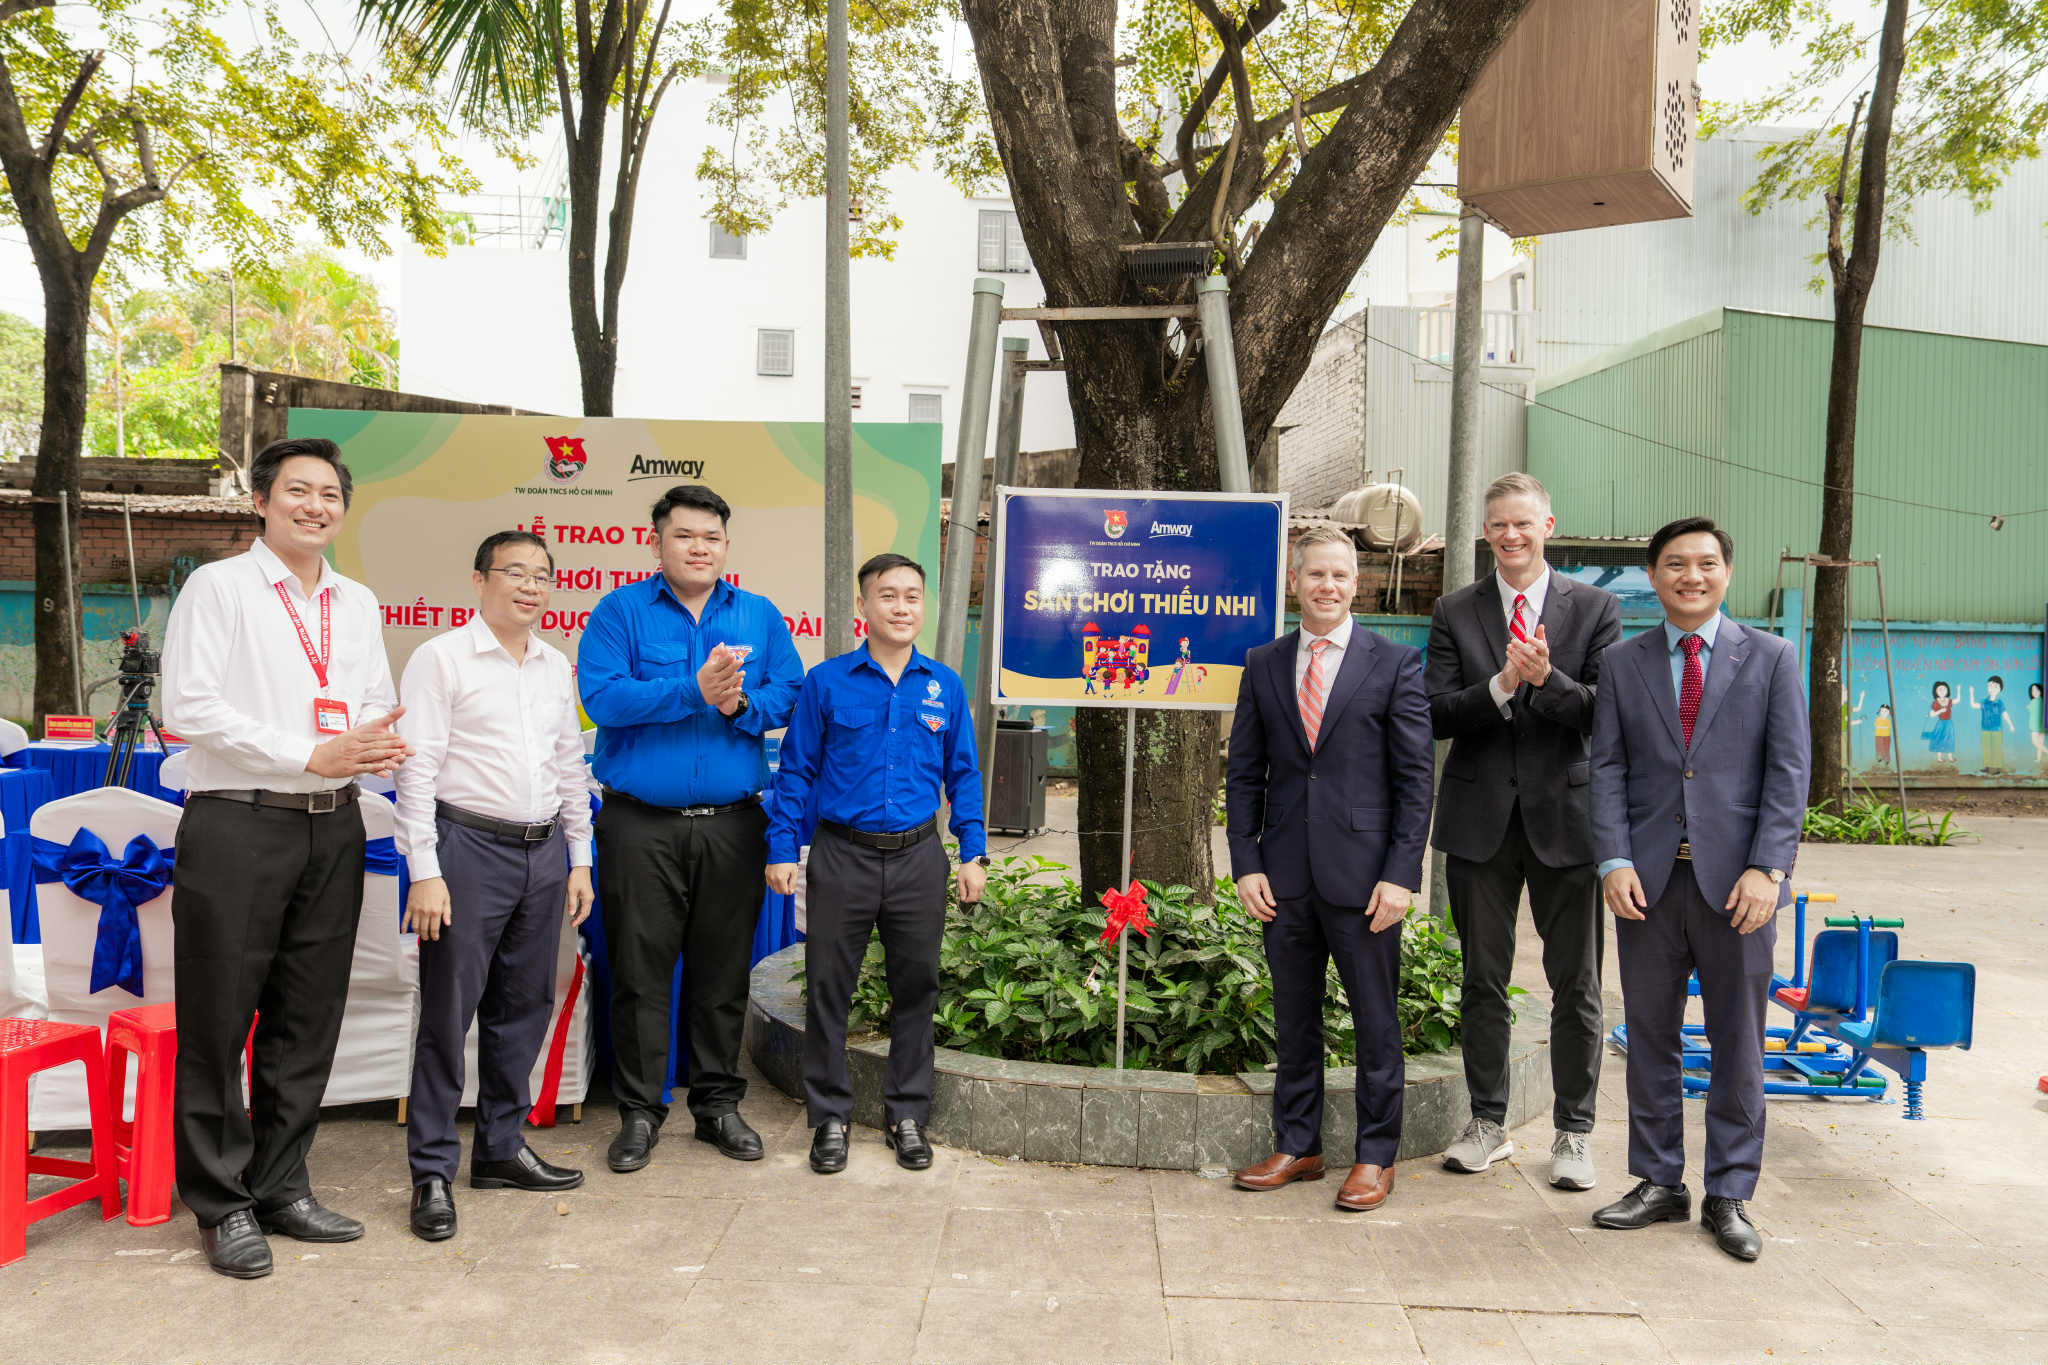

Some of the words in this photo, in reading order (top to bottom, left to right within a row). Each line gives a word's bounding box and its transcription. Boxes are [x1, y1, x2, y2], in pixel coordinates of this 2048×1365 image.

[630, 455, 705, 480] Amway
[514, 487, 526, 495] TW
[527, 486, 548, 496] ĐOÀN
[549, 487, 568, 496] TNCS
[568, 485, 580, 496] HỒ
[580, 486, 593, 496] CHÍ
[594, 488, 613, 497] MINH
[517, 516, 546, 542] Ễ
[554, 525, 625, 545] TRAO
[1150, 520, 1193, 537] Amway
[552, 566, 602, 591] HƠI
[1090, 562, 1140, 578] TRAO
[1143, 560, 1192, 584] TẶNG
[379, 596, 444, 627] HIẾT
[1078, 588, 1135, 614] CHƠI
[1140, 584, 1209, 616] THIẾU
[1215, 595, 1256, 617] NHI
